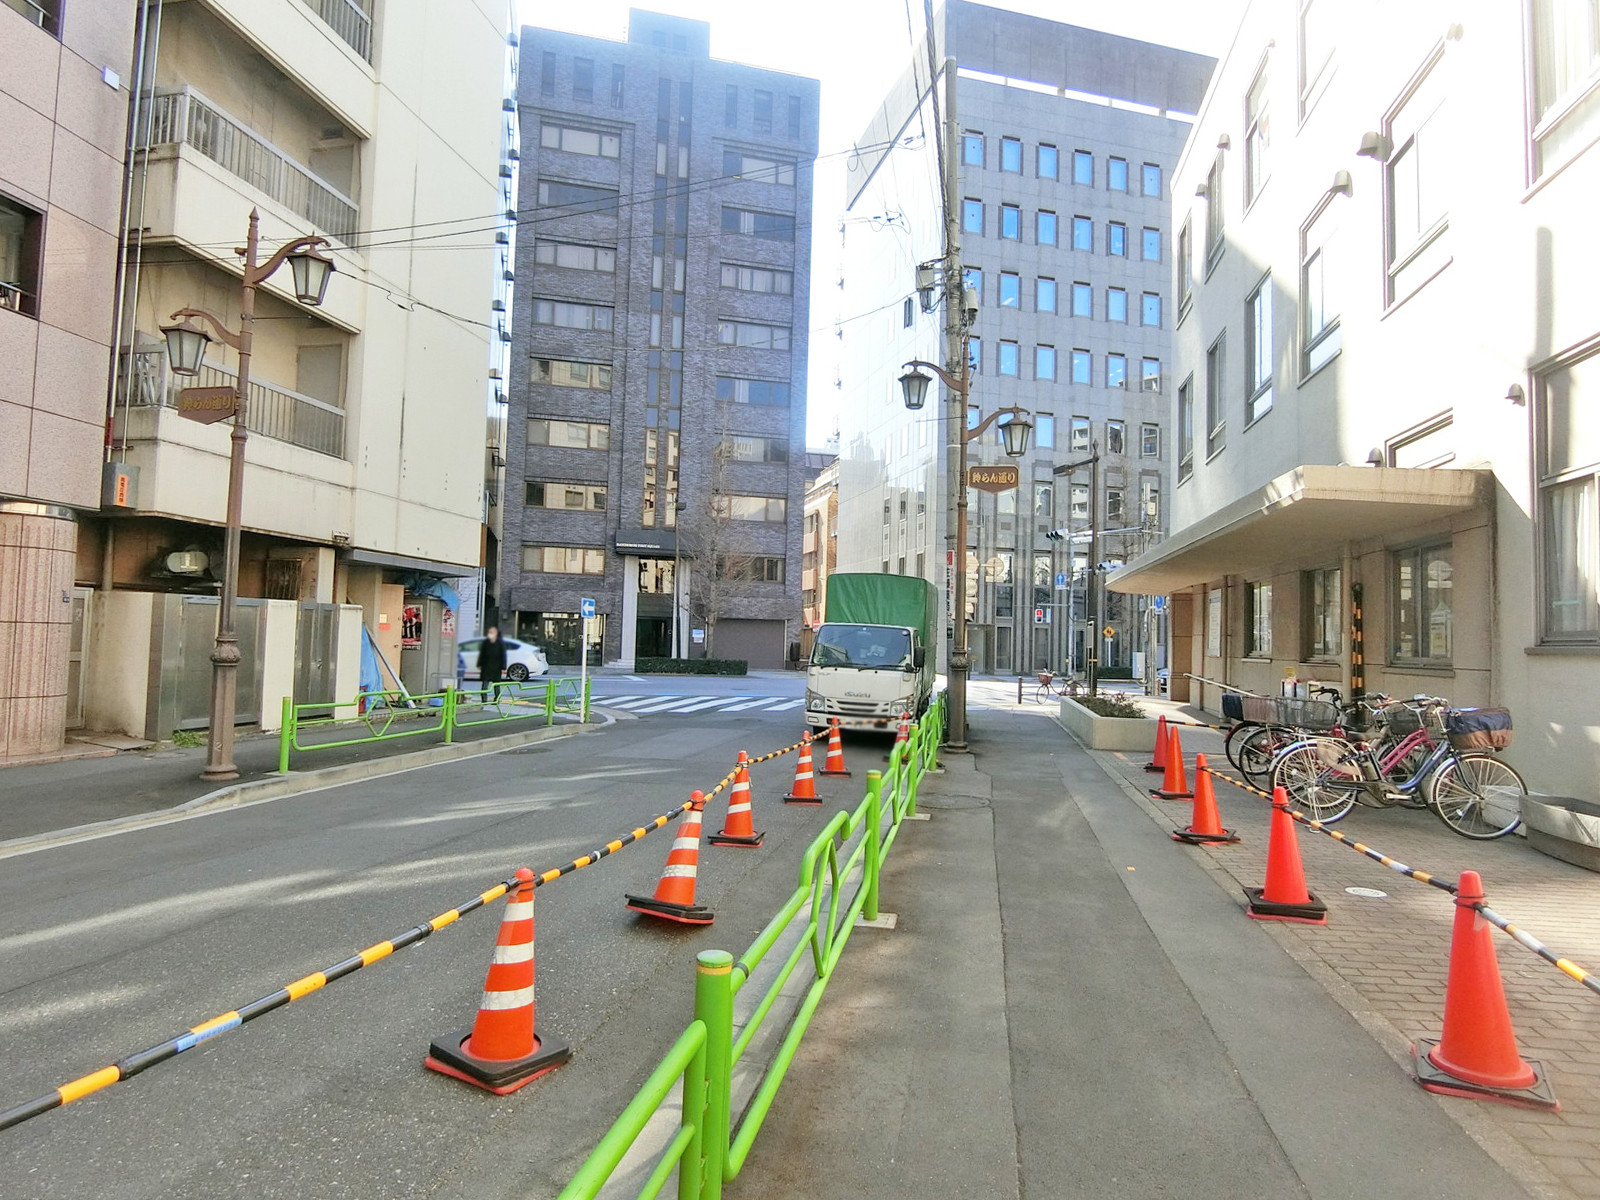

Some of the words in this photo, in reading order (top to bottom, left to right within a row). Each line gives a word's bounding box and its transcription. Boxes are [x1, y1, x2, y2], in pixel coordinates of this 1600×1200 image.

[972, 471, 1016, 484] 鈴らん通り
